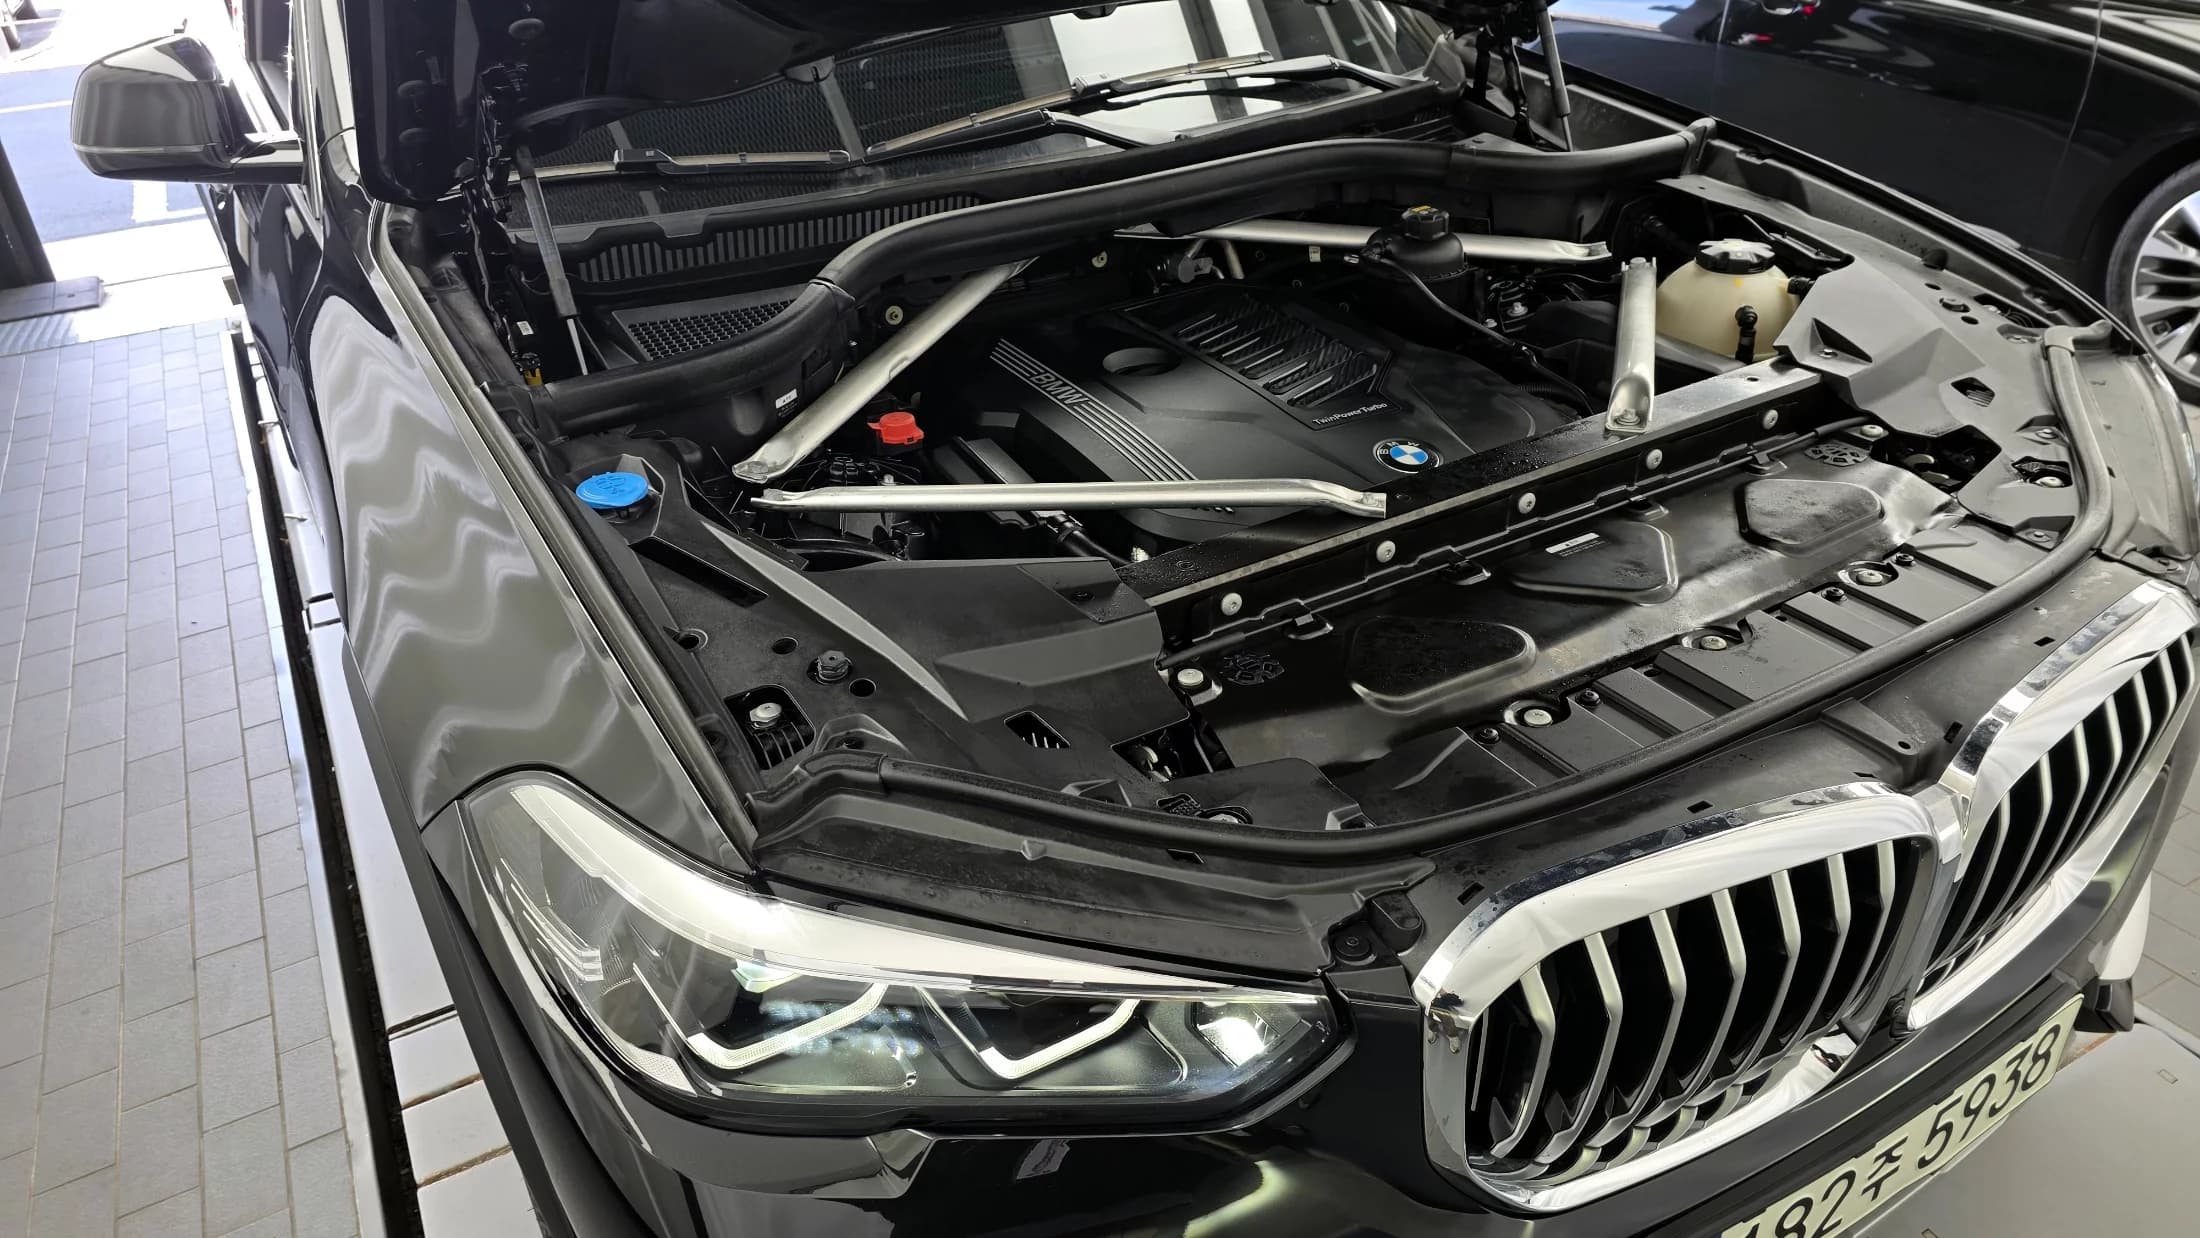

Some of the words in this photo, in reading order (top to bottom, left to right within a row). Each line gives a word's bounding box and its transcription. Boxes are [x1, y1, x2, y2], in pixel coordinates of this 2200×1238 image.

[1030, 372, 1090, 404] BMW
[1744, 1136, 1908, 1238] 82주
[1918, 1024, 2060, 1169] 5938
